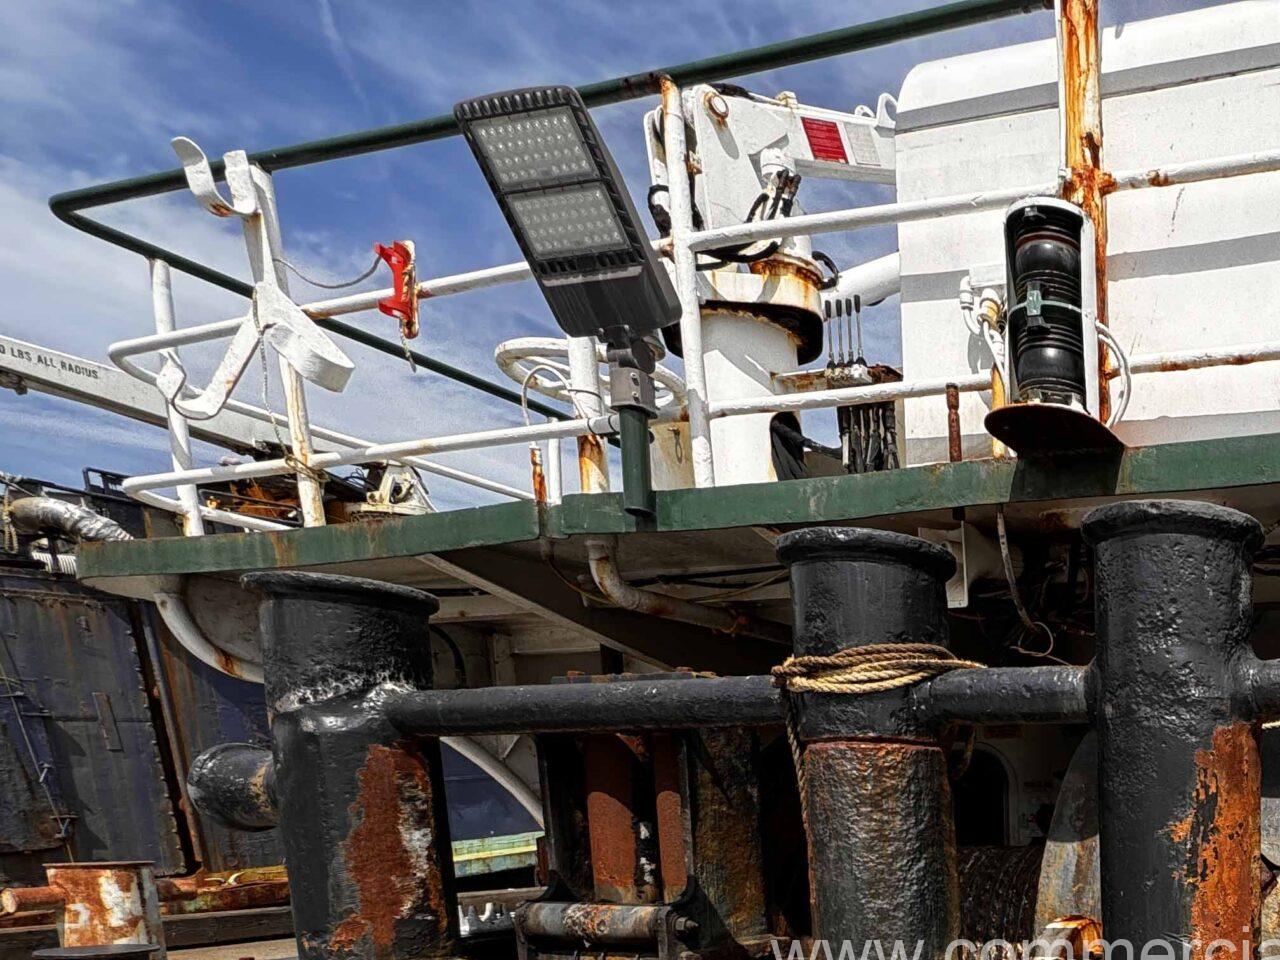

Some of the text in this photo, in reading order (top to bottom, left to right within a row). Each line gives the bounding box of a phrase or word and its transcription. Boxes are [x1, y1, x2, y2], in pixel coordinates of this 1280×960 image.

[10, 347, 32, 361] LBS
[37, 355, 57, 368] ALL
[60, 360, 99, 379] RADIUS
